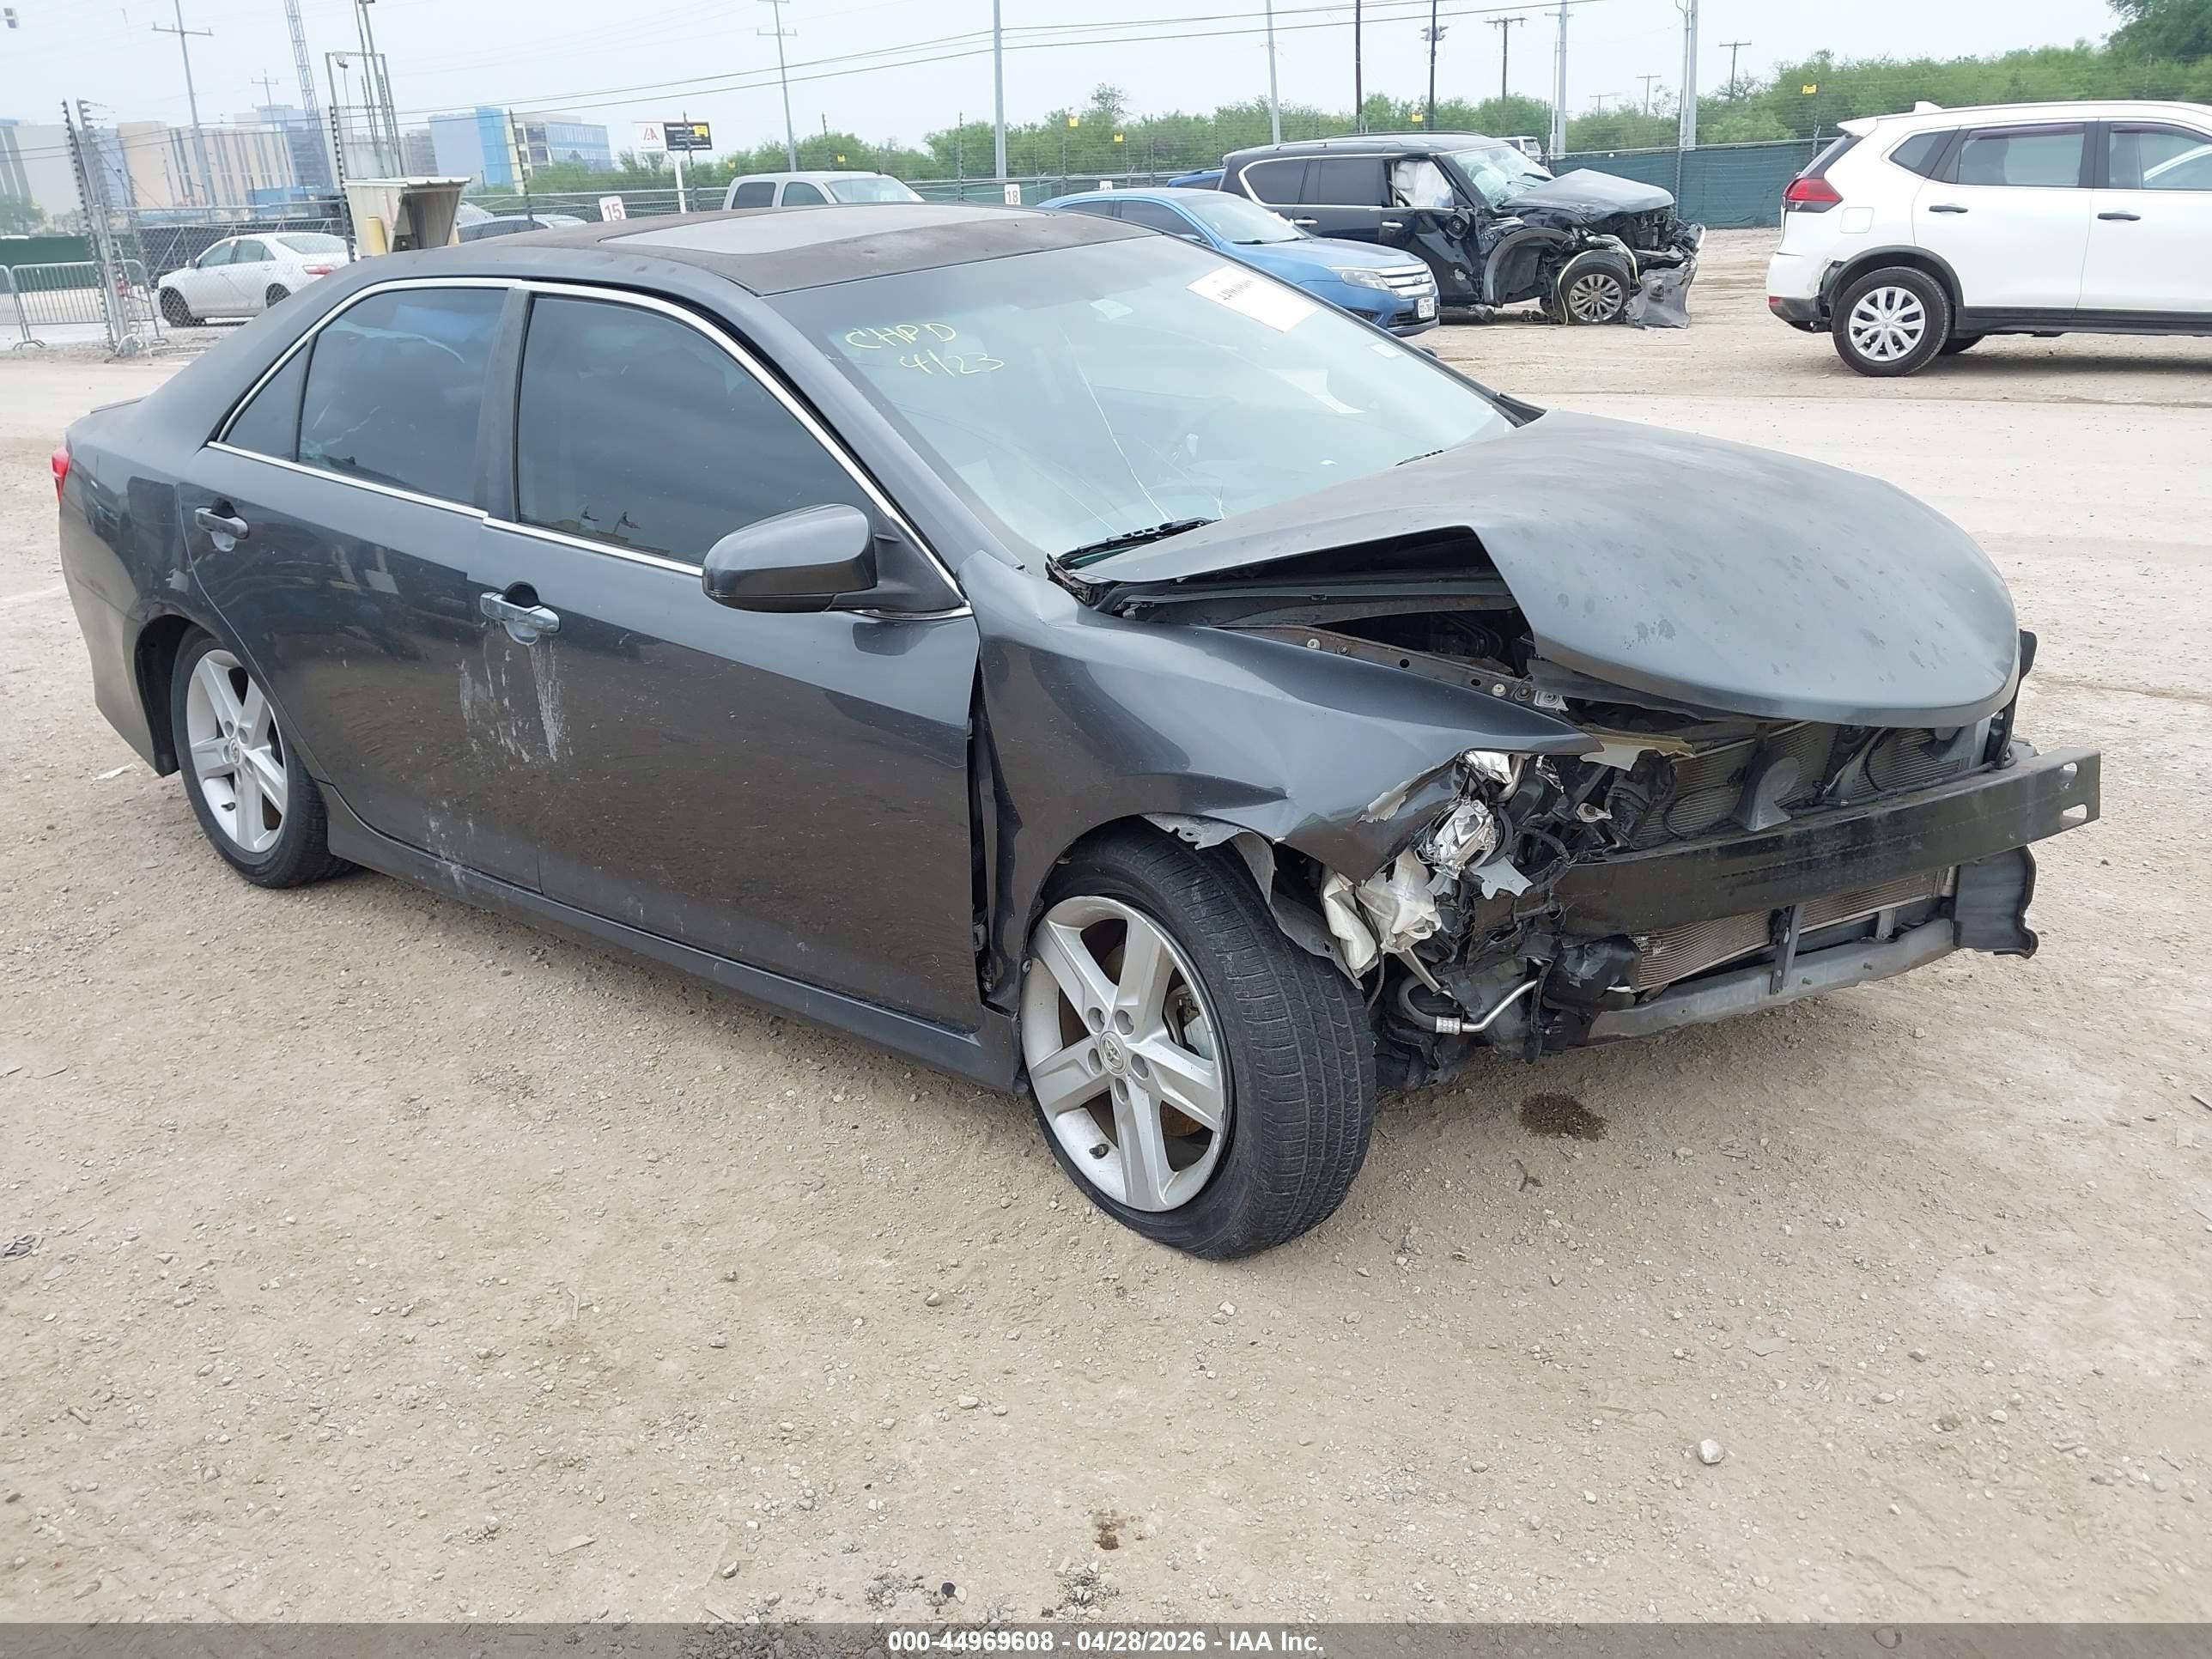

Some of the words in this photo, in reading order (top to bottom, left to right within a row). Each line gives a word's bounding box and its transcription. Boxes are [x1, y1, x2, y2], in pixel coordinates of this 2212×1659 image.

[1006, 190, 1018, 204] 18
[605, 203, 622, 221] 15
[845, 323, 957, 349] CHPD
[899, 349, 1004, 378] 4/23
